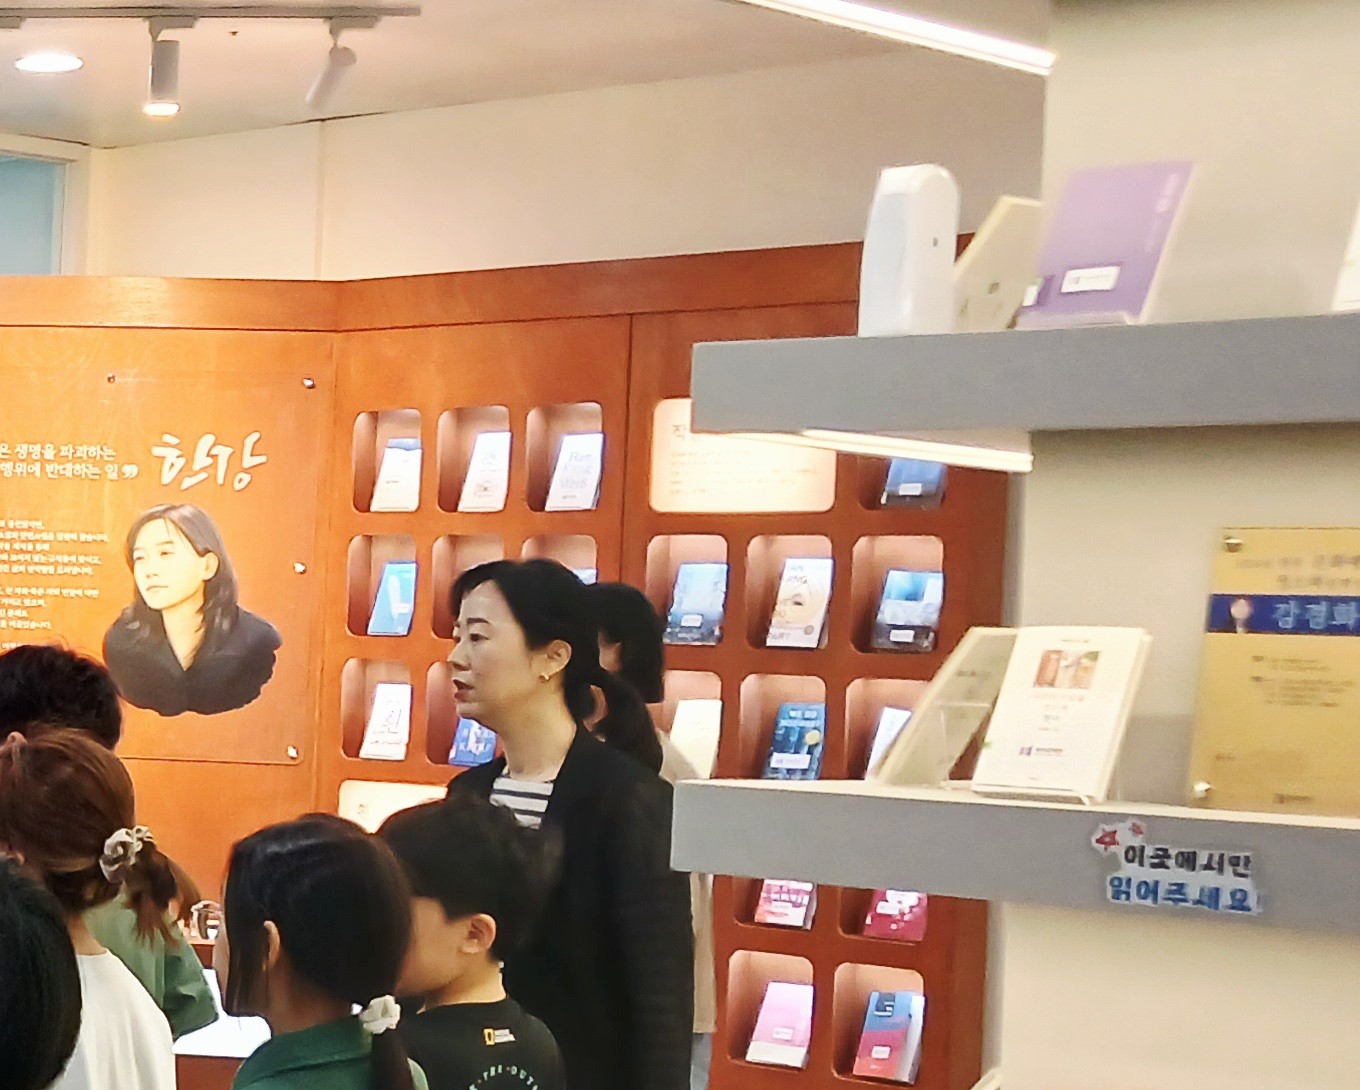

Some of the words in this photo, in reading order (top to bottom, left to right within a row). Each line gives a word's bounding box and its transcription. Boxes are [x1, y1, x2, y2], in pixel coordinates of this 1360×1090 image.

[14, 443, 57, 460] 생명을
[59, 444, 117, 461] 파괴하는
[150, 431, 268, 491] 한강
[0, 461, 41, 478] 행위에
[44, 462, 102, 480] 반대하는
